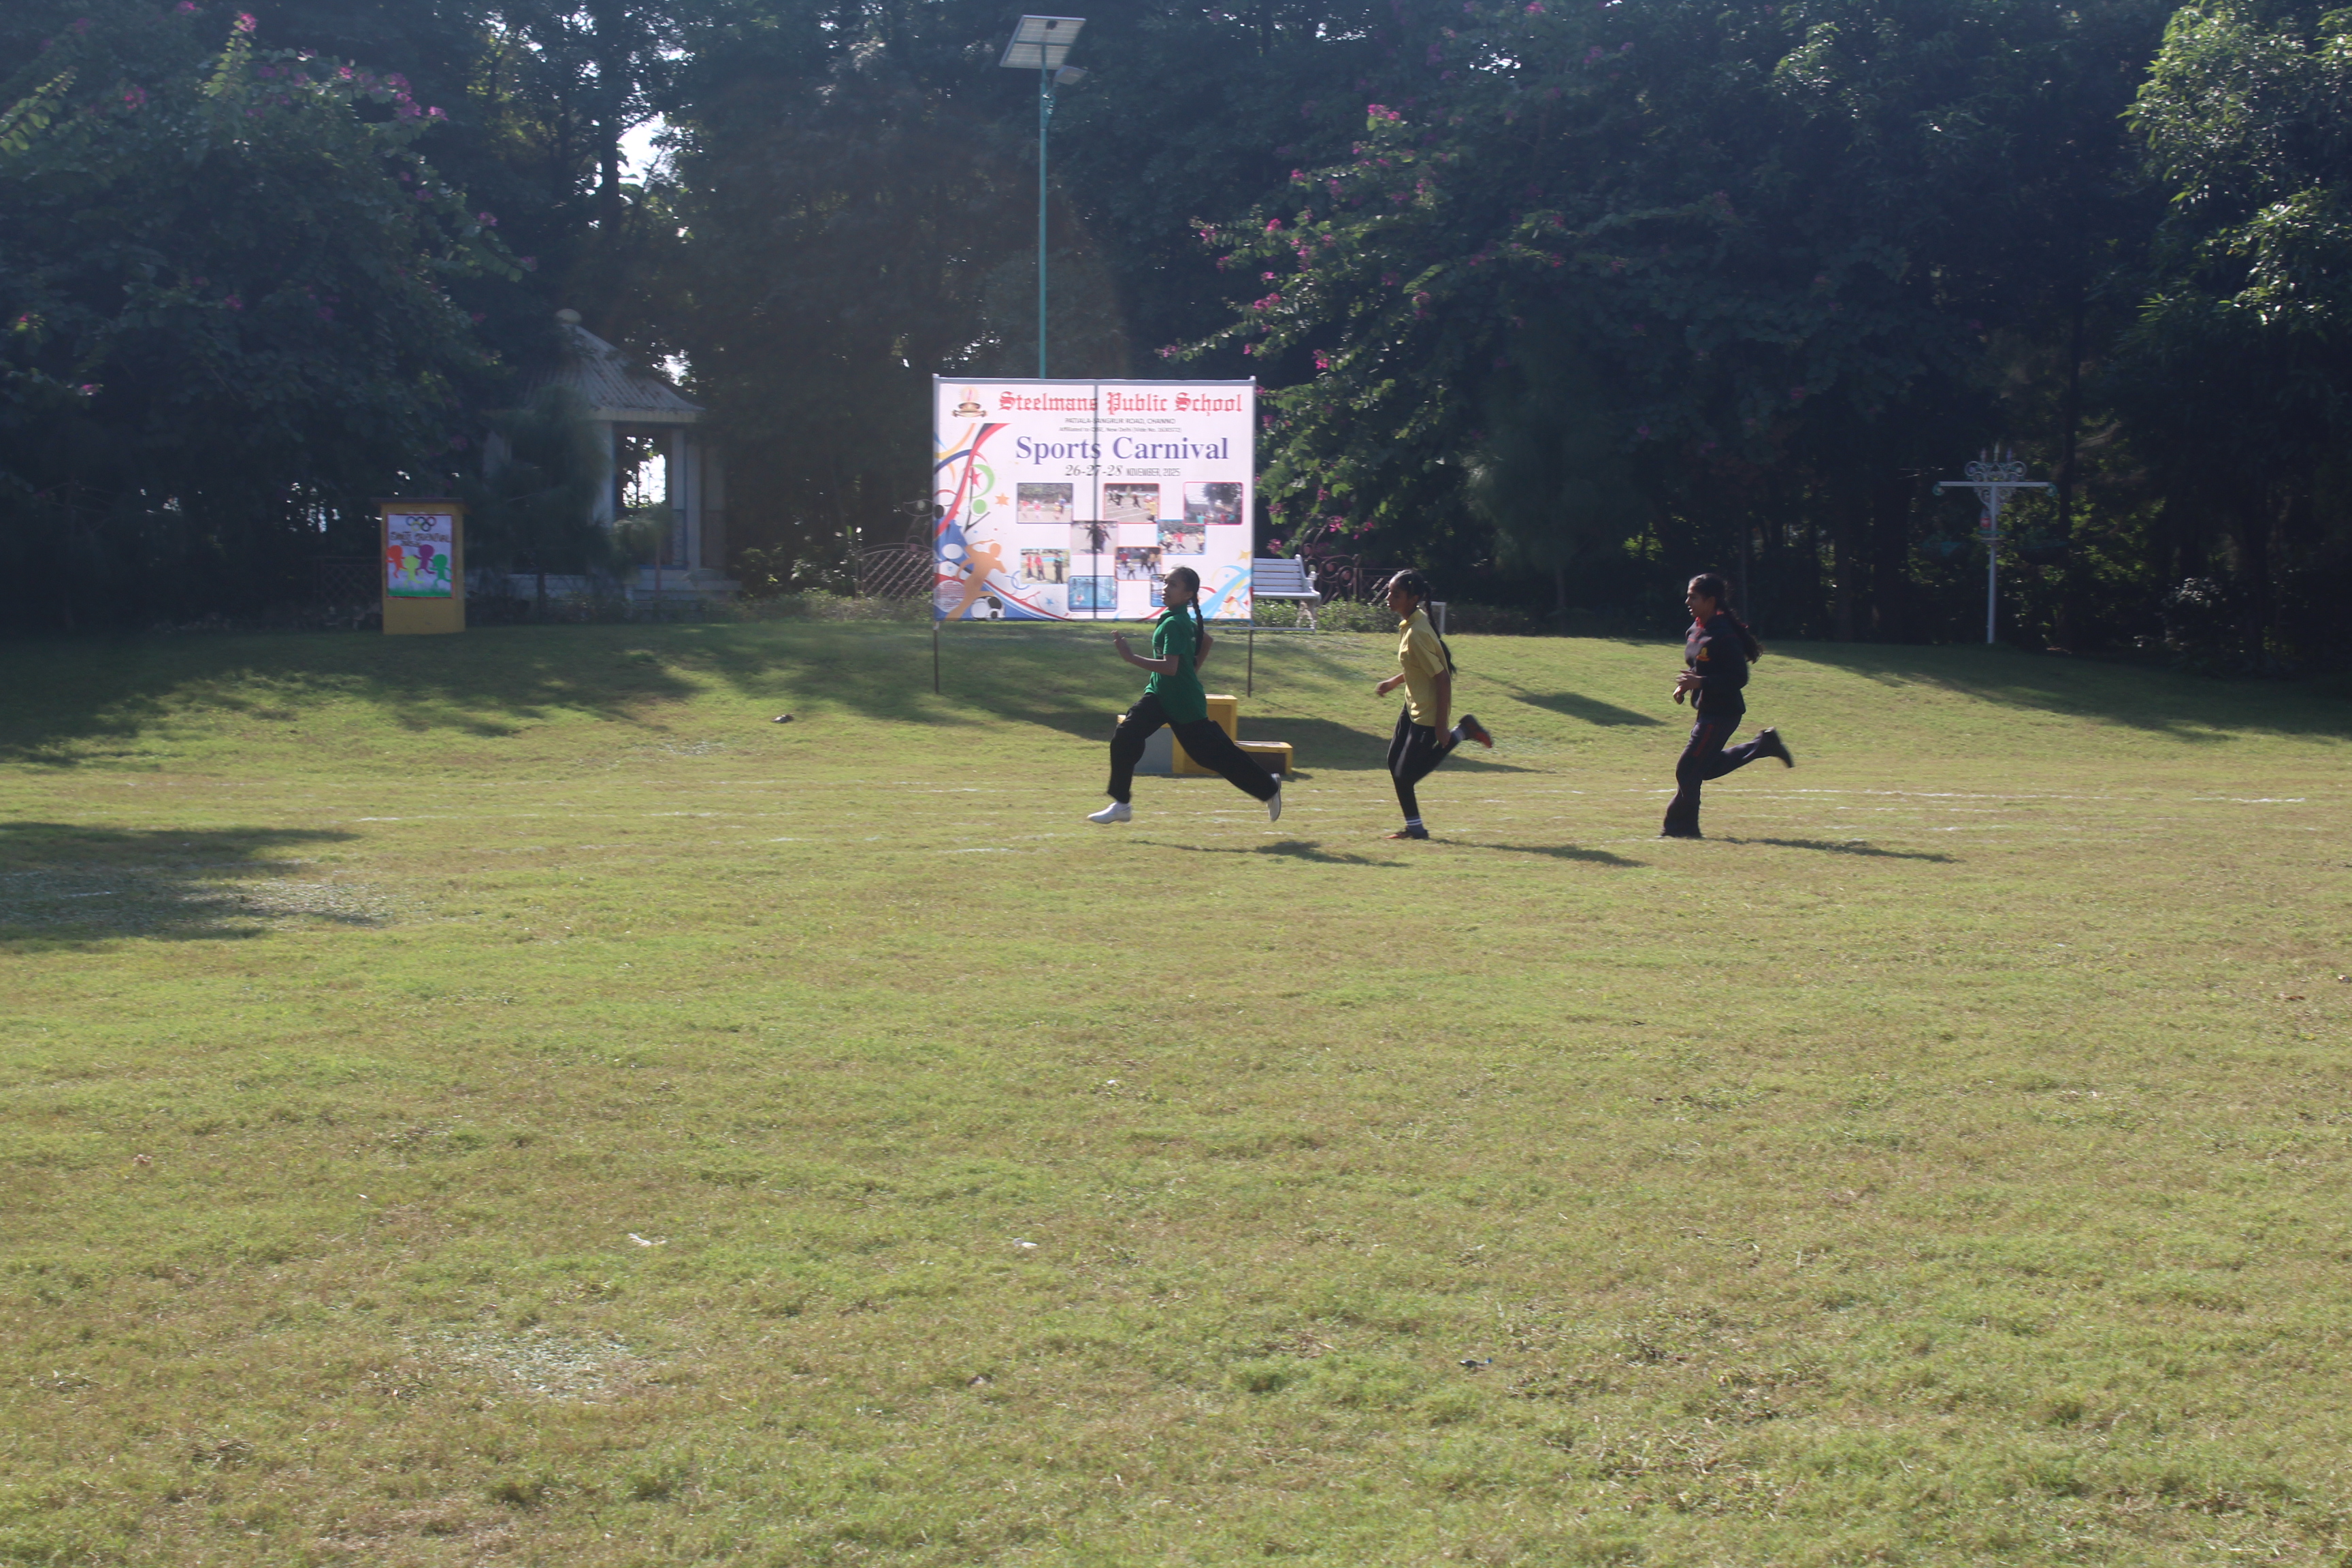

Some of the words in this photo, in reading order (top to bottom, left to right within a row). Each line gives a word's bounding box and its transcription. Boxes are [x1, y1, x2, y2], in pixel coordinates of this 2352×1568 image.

[998, 391, 1098, 412] Steelmans
[1107, 391, 1169, 415] Public
[1175, 391, 1243, 416] School
[1015, 436, 1101, 465] Sports
[1113, 436, 1229, 459] Carnival
[1126, 468, 1162, 477] NOVEMBER,
[1163, 468, 1181, 476] 2025
